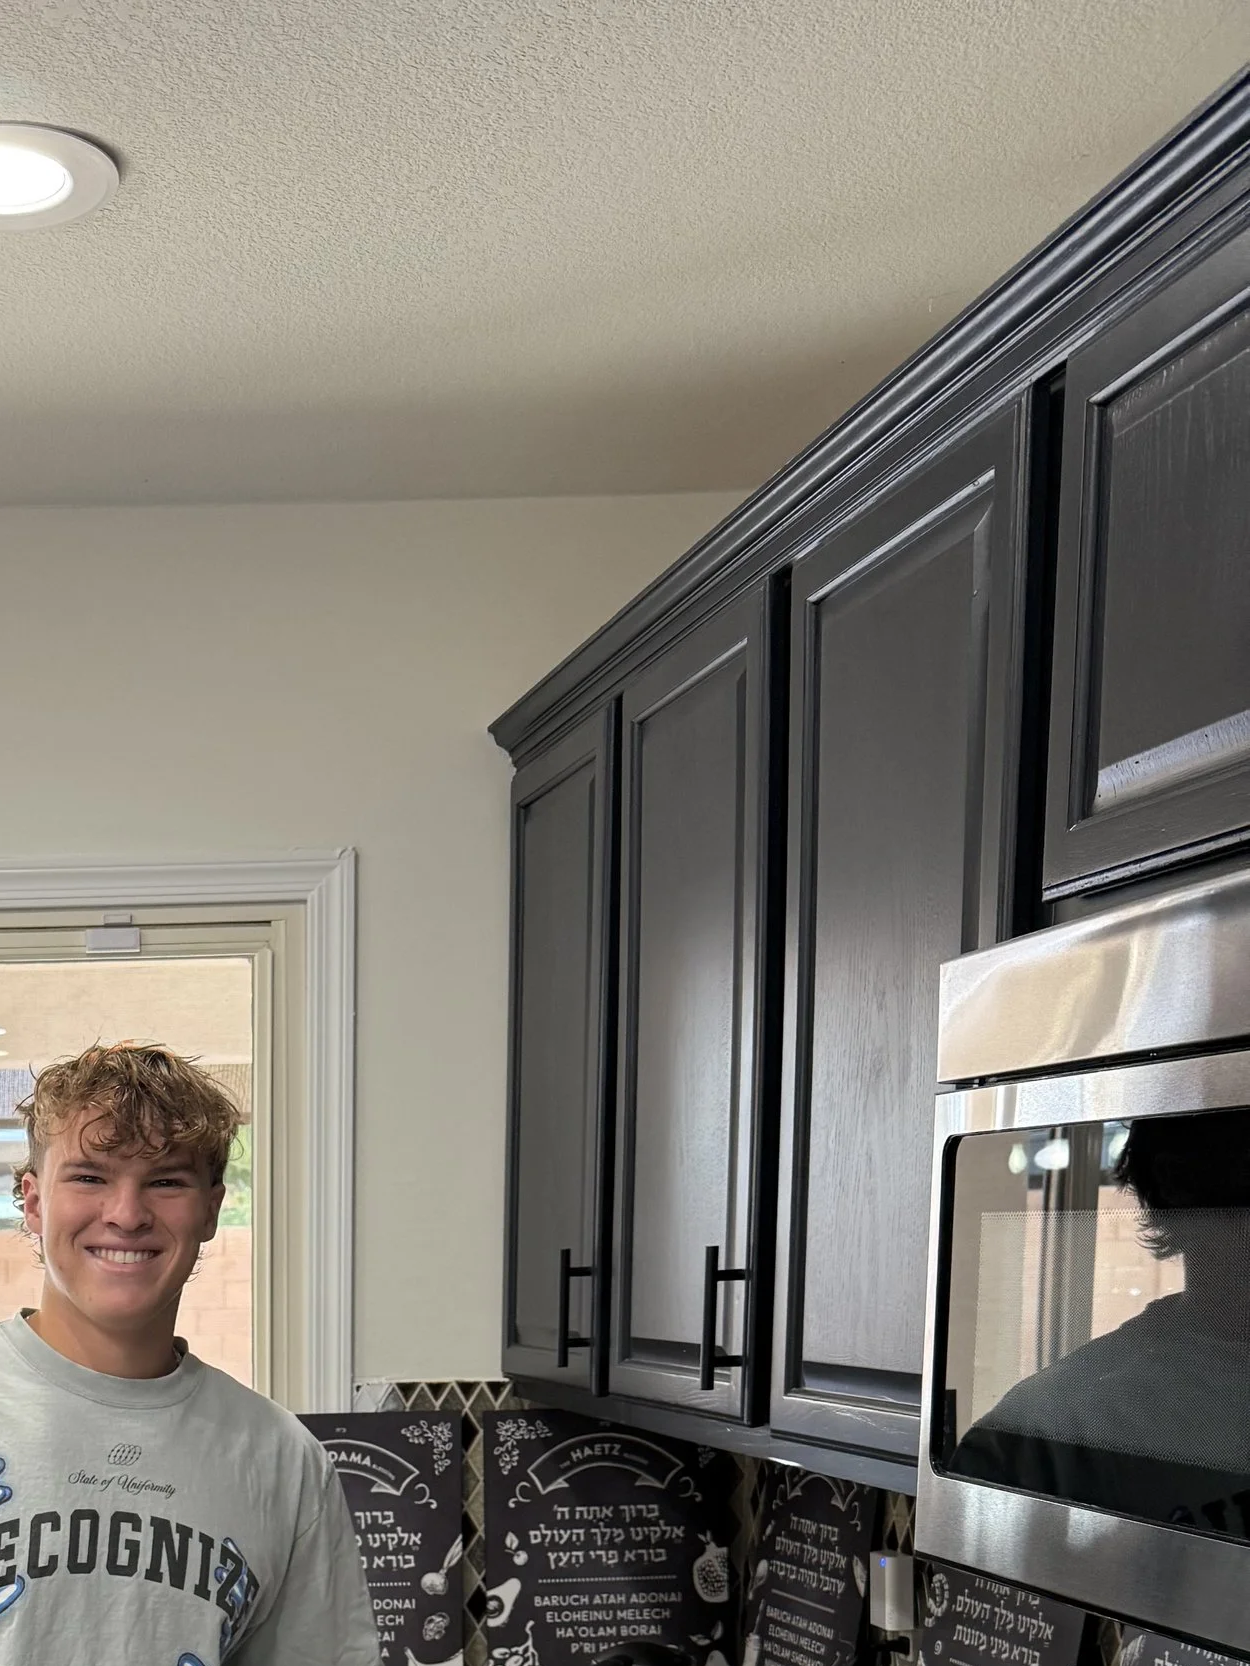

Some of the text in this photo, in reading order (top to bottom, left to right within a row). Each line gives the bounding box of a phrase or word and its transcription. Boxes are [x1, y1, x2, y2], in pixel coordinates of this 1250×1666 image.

[327, 1450, 371, 1466] DAMA
[570, 1444, 621, 1461] HAETZ
[68, 1470, 176, 1498] State of Uniformity
[373, 1599, 416, 1610] DONAI
[534, 1592, 683, 1607] BARUCH ATAH ADONAI
[546, 1608, 671, 1623] ELOHEINU MELECH
[556, 1624, 662, 1639] HA'OLAM BORAI
[571, 1642, 596, 1654] P'RI
